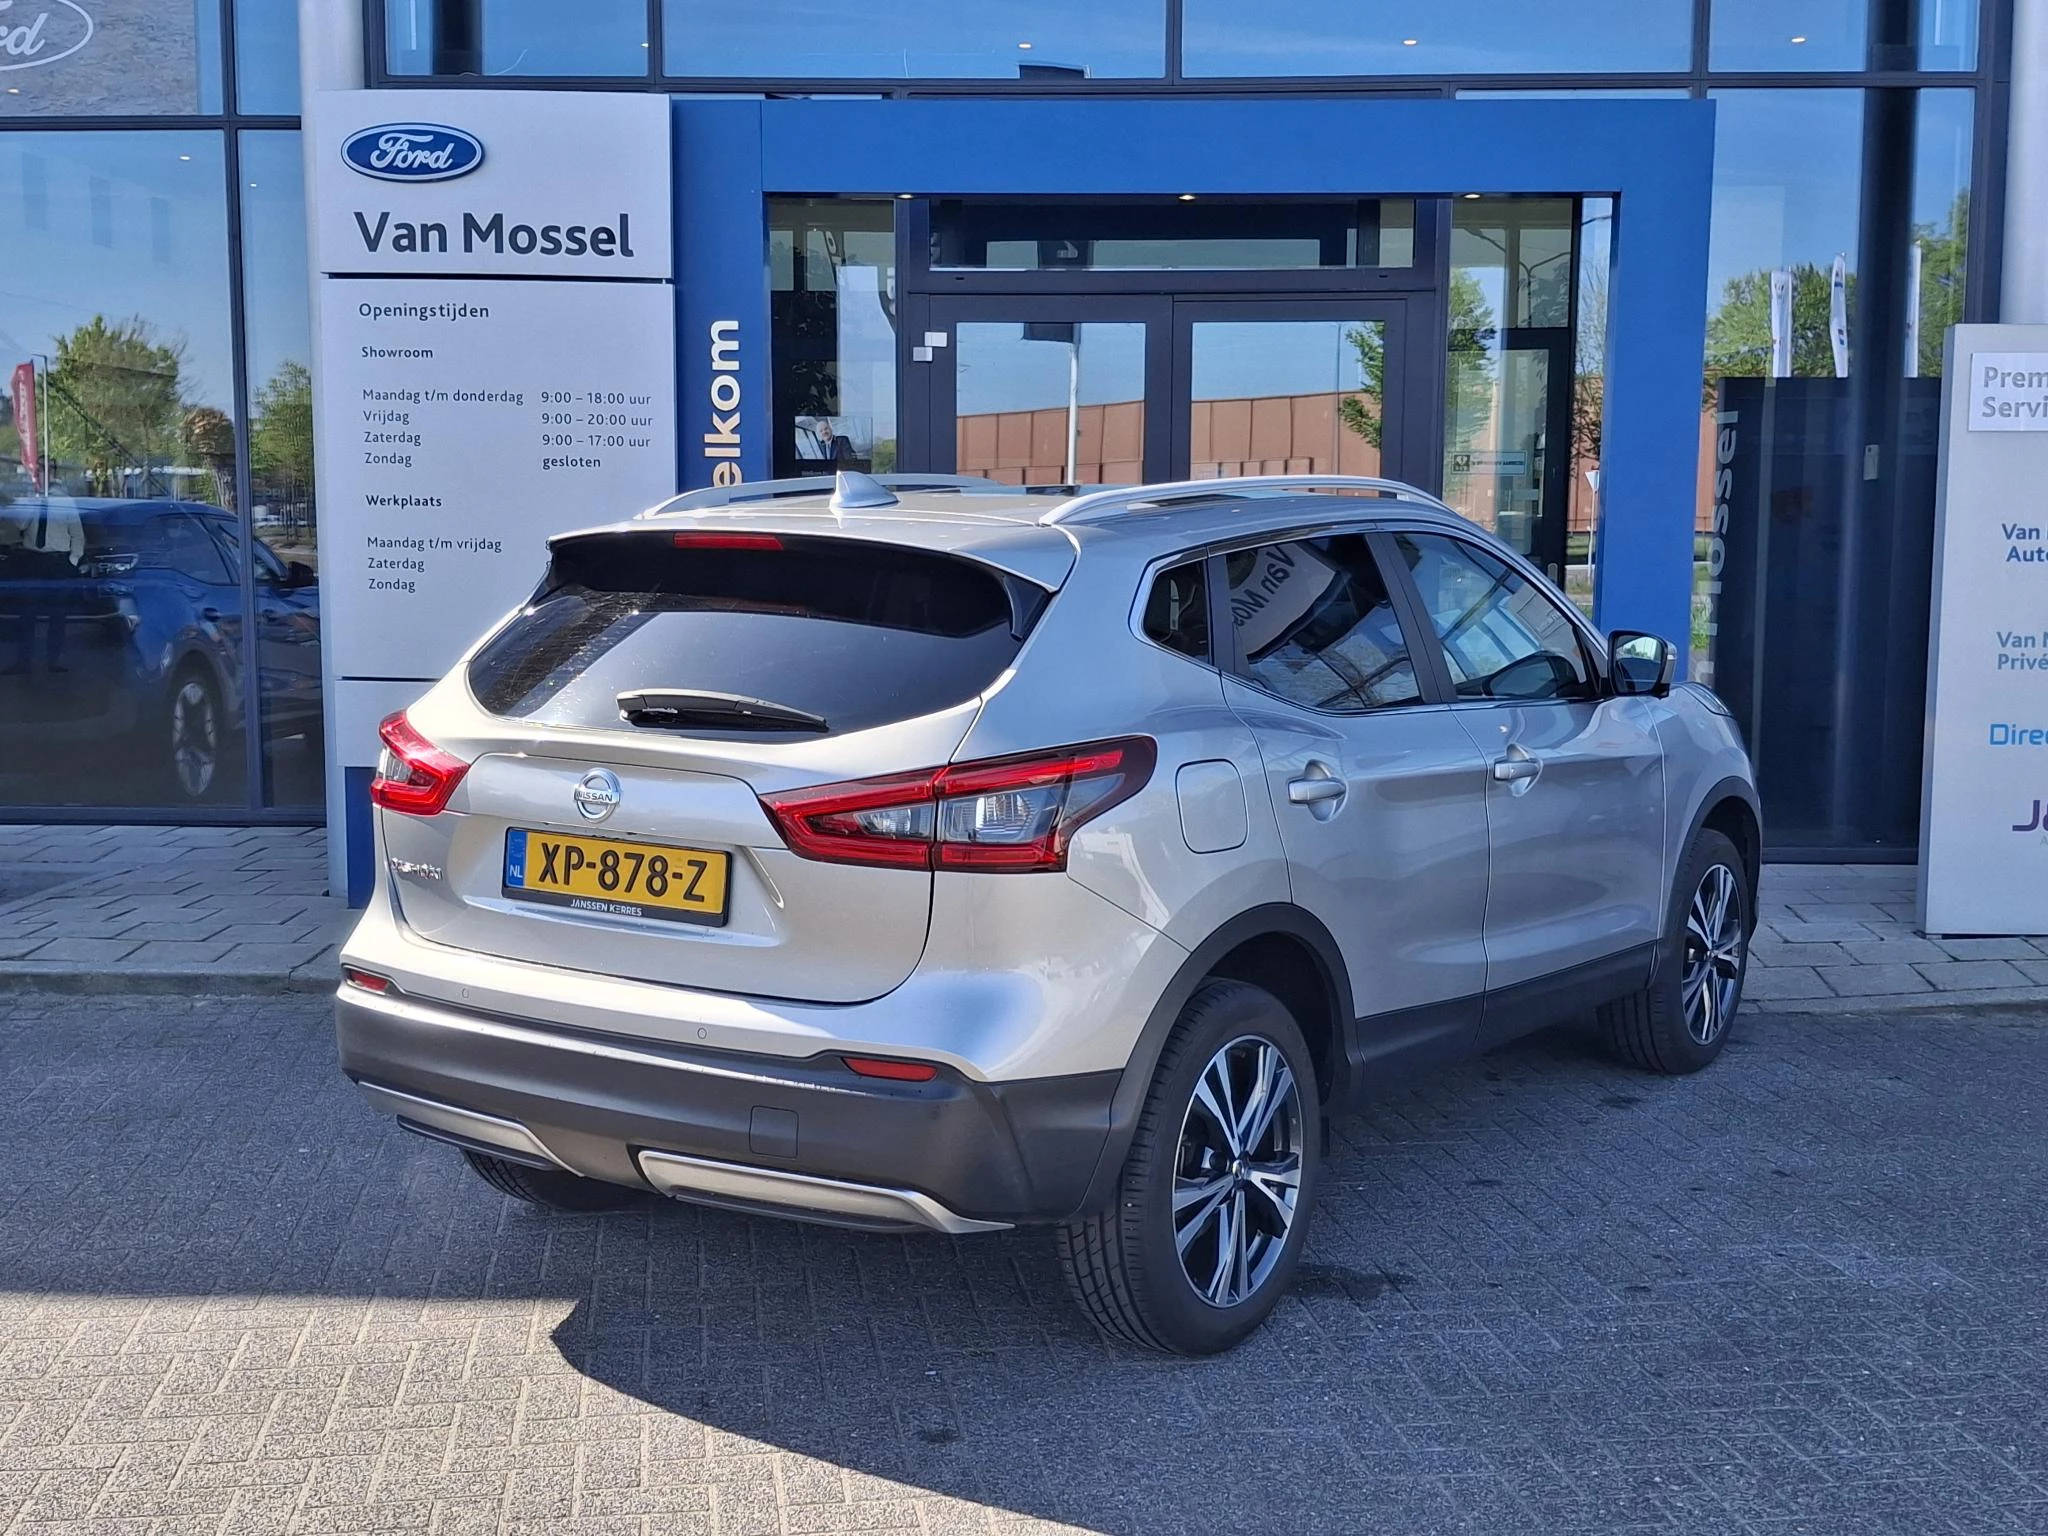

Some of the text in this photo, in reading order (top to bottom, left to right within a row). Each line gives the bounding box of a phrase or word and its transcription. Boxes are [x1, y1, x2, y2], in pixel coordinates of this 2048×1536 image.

[370, 131, 455, 169] Ford
[354, 212, 634, 257] Van Mossel
[359, 302, 489, 322] Openingstijden
[361, 345, 434, 359] Showroom
[362, 388, 421, 405] Maandag
[424, 389, 449, 402] t/m
[452, 389, 524, 406] donderdag
[541, 391, 572, 404] 9:00
[587, 392, 625, 405] 18:00
[629, 395, 651, 405] uur
[1981, 396, 2048, 418] Servi
[362, 409, 410, 426] Vrijdag
[541, 412, 572, 425] 9:00
[587, 413, 627, 426] 20:00
[631, 416, 653, 426] uur
[364, 431, 422, 447] Zaterdag
[542, 433, 573, 446] 9:00
[588, 434, 624, 447] 17:00
[628, 437, 651, 448] uur
[364, 452, 601, 471] Zondag gesloten
[365, 494, 442, 510] Werkplaats
[2001, 523, 2040, 540] Van
[367, 536, 502, 554] Maandag t/m vrijdag
[367, 557, 425, 573] Zaterdag
[368, 577, 416, 594] Zondag
[1996, 631, 2036, 648] Van
[575, 791, 613, 802] NISSAN
[509, 865, 524, 878] NL
[538, 842, 708, 902] XP-878-Z
[570, 898, 608, 912] JANSSEN
